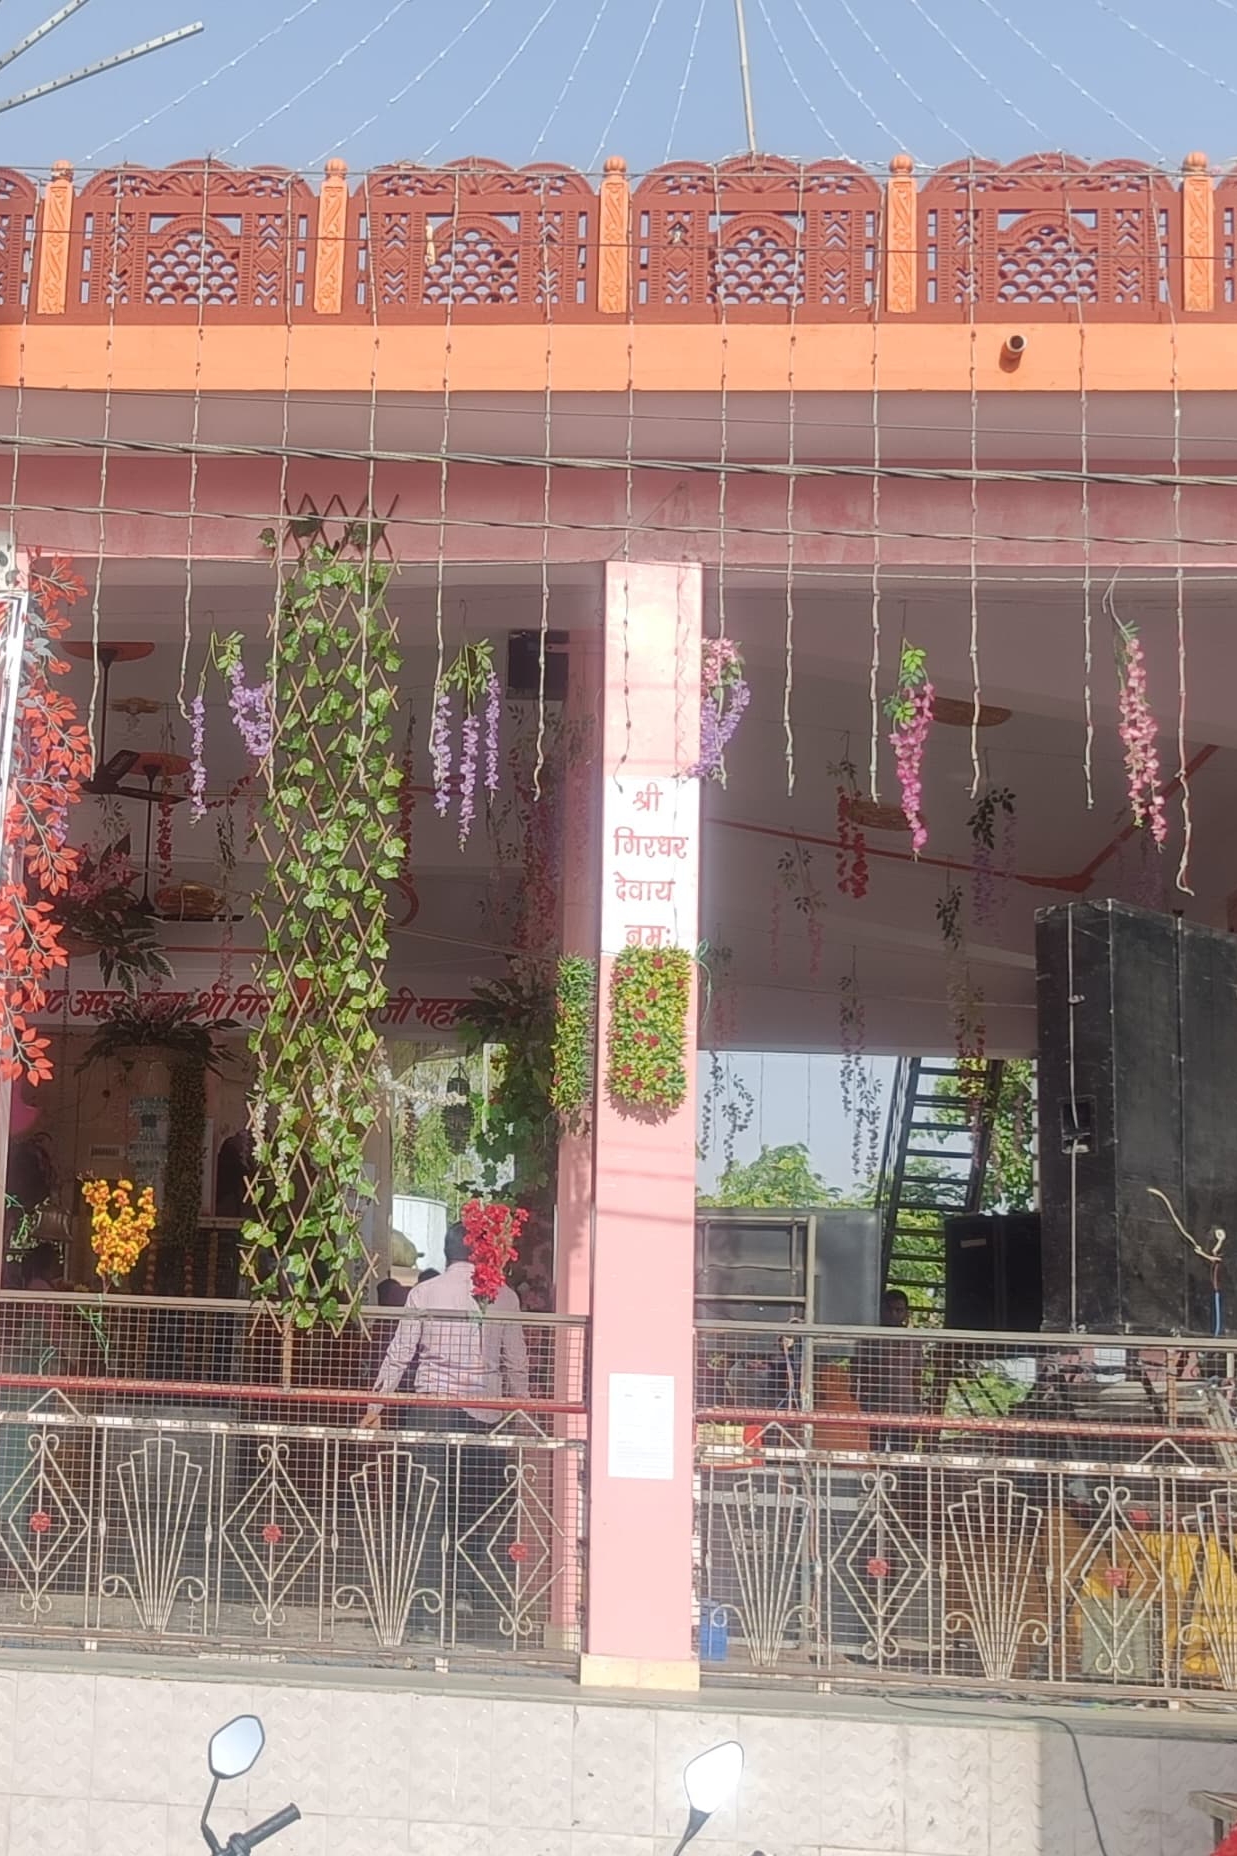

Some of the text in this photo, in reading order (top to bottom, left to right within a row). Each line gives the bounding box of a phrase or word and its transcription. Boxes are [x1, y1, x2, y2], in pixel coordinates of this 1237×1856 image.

[632, 782, 664, 812] श्री
[612, 826, 690, 860] गिरधर
[612, 871, 677, 902] देवाय
[624, 924, 672, 947] नमः
[188, 982, 231, 1020] श्री
